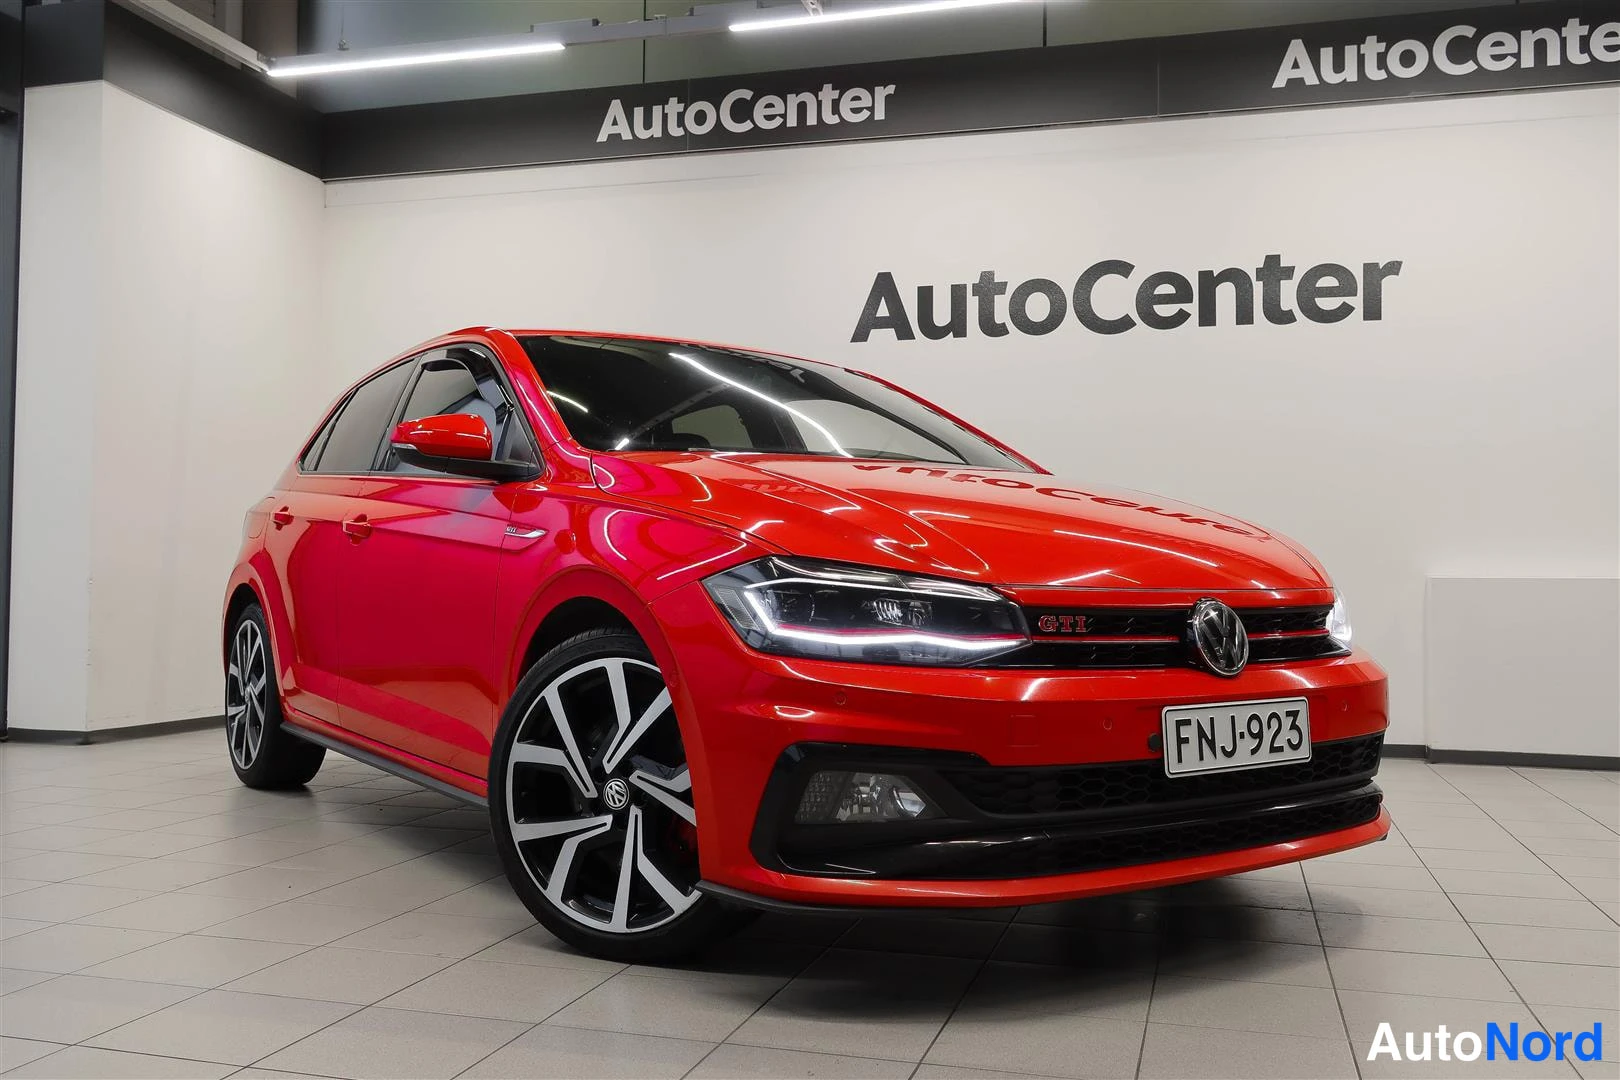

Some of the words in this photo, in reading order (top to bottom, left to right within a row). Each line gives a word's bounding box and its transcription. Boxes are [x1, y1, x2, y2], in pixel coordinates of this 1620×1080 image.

[596, 84, 896, 142] AutoCenter
[850, 254, 1403, 342] AutoCenter
[1038, 615, 1086, 632] GTI
[1175, 710, 1303, 763] FNJ-923
